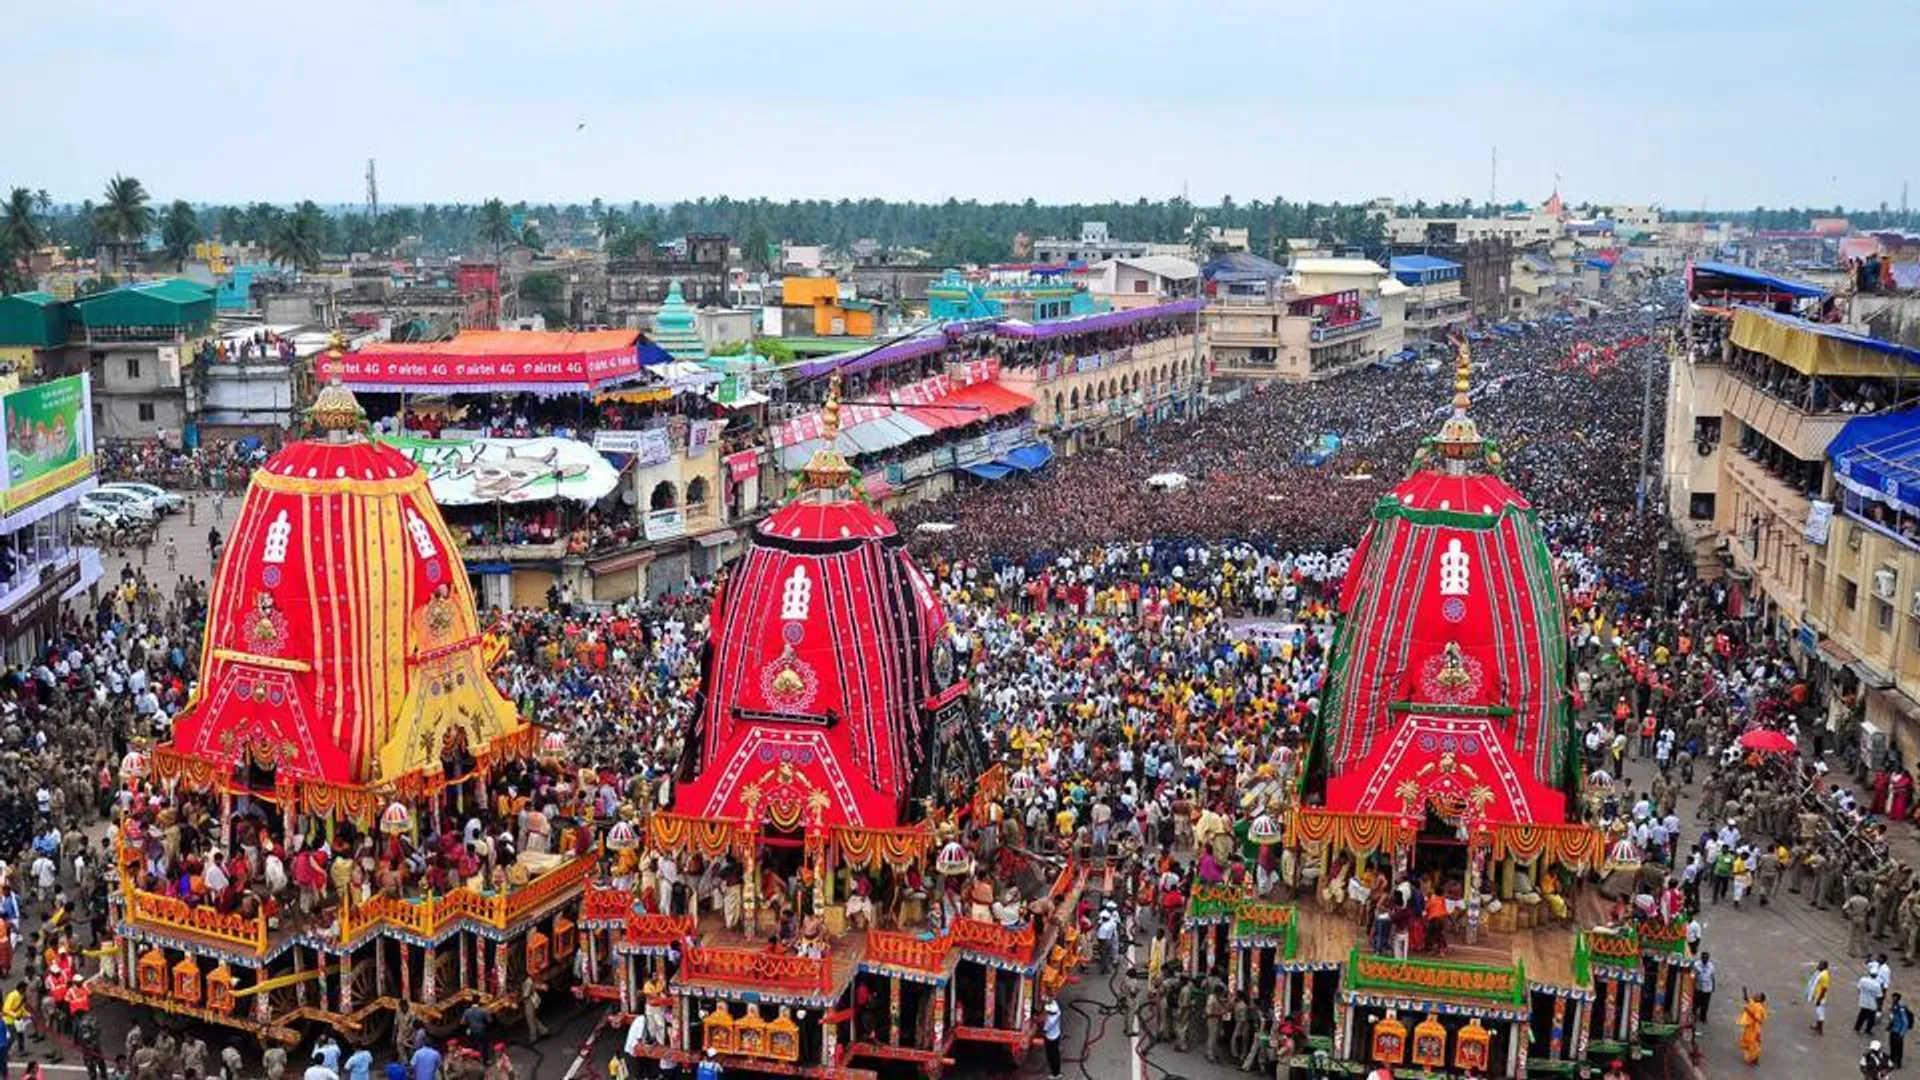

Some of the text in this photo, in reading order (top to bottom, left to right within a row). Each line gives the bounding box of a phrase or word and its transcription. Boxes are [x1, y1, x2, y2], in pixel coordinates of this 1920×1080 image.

[364, 363, 380, 375] 4G
[398, 362, 427, 375] airtel
[432, 364, 447, 375] 4G
[466, 362, 495, 375] airtel
[500, 362, 515, 374] 4G
[534, 361, 562, 374] airtel
[567, 362, 582, 373] 4G
